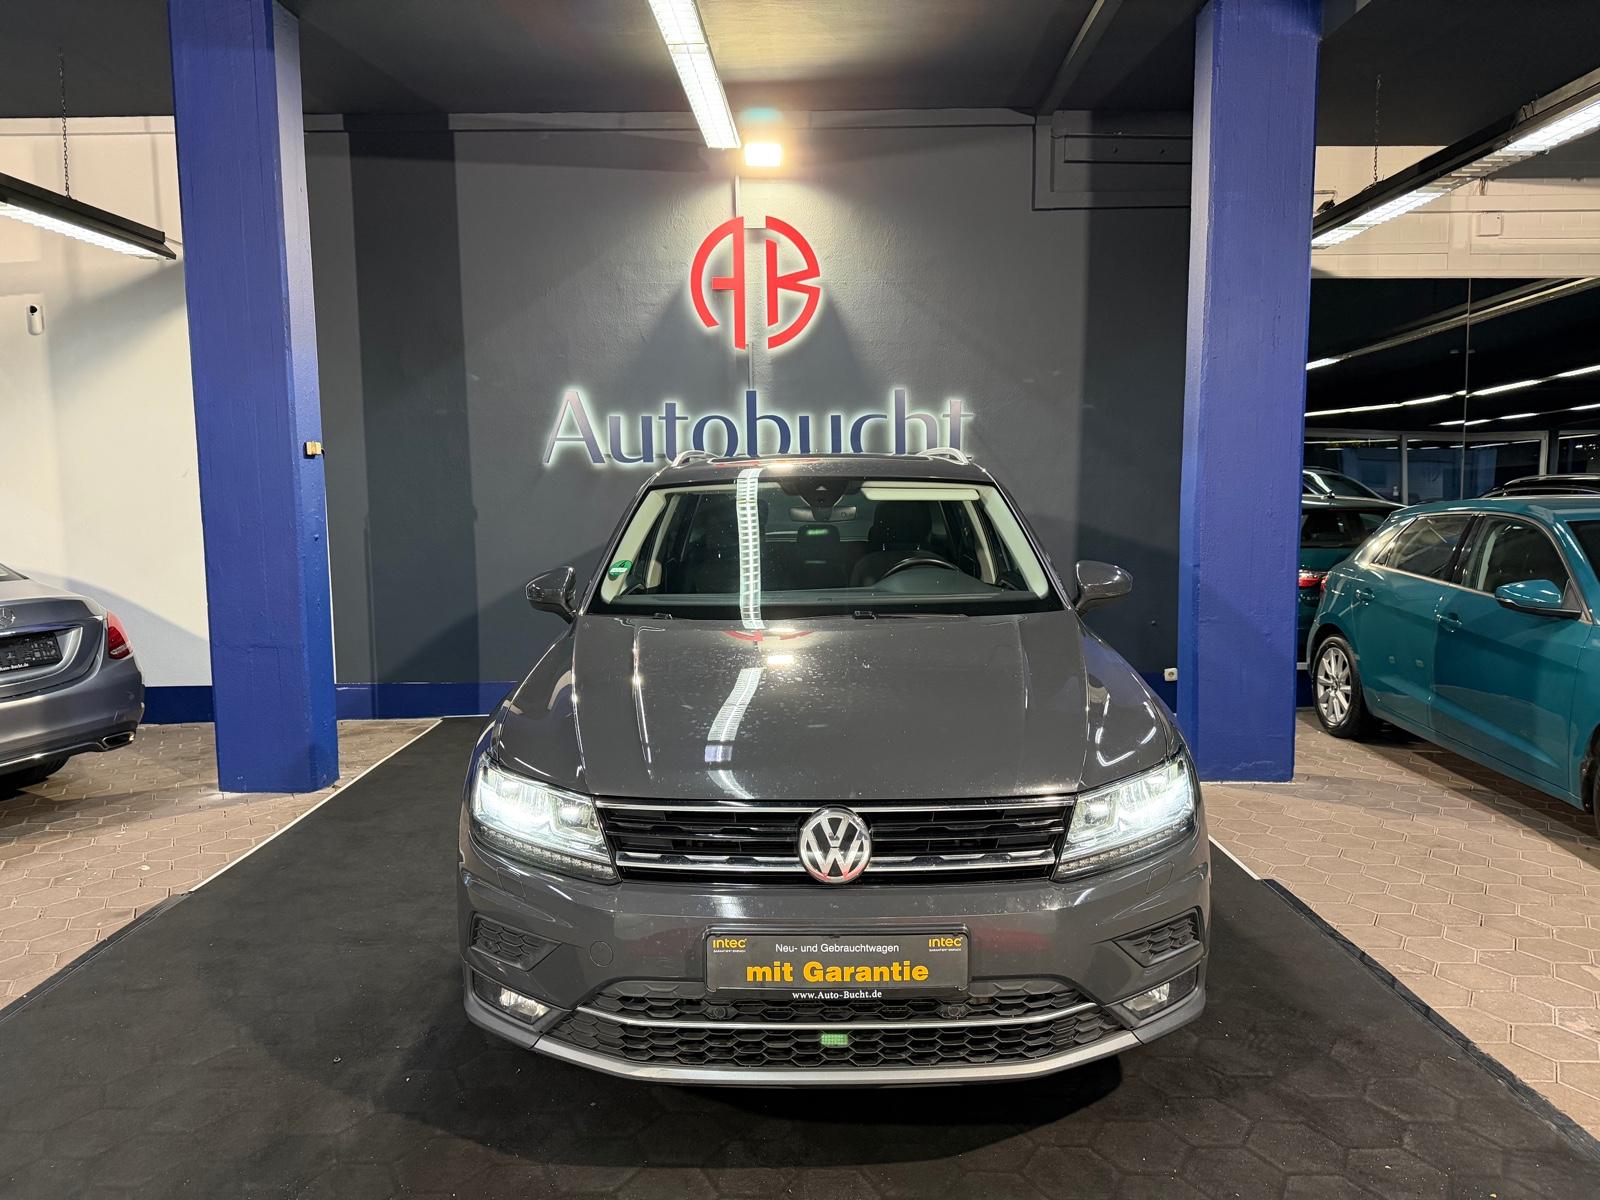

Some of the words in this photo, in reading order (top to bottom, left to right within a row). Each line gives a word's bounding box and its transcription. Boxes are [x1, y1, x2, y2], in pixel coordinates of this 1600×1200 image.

[541, 389, 976, 464] Autobucht
[712, 938, 747, 948] intec
[928, 937, 963, 948] intec
[775, 943, 798, 953] Neu-
[800, 943, 818, 953] und
[820, 943, 900, 955] Gebrauchtwagen
[746, 960, 794, 982] mit
[803, 960, 929, 983] Garantie
[792, 989, 882, 999] www.Auto-Bucht.de
